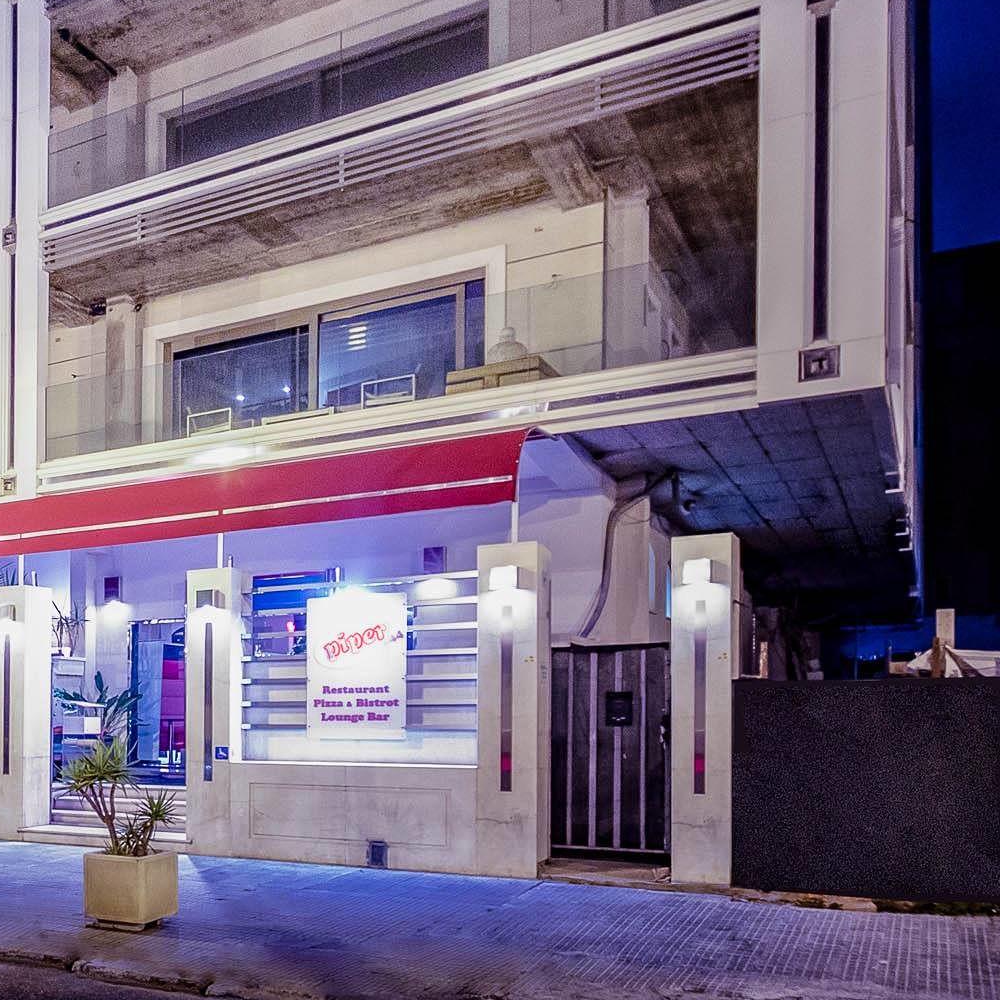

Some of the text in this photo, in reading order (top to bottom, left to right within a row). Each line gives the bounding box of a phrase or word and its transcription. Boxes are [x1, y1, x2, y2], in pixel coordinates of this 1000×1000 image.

[322, 685, 390, 694] Restaurant
[313, 699, 344, 708] Pizza
[356, 698, 400, 708] Bistrot
[320, 712, 390, 723] Lounge Bar
